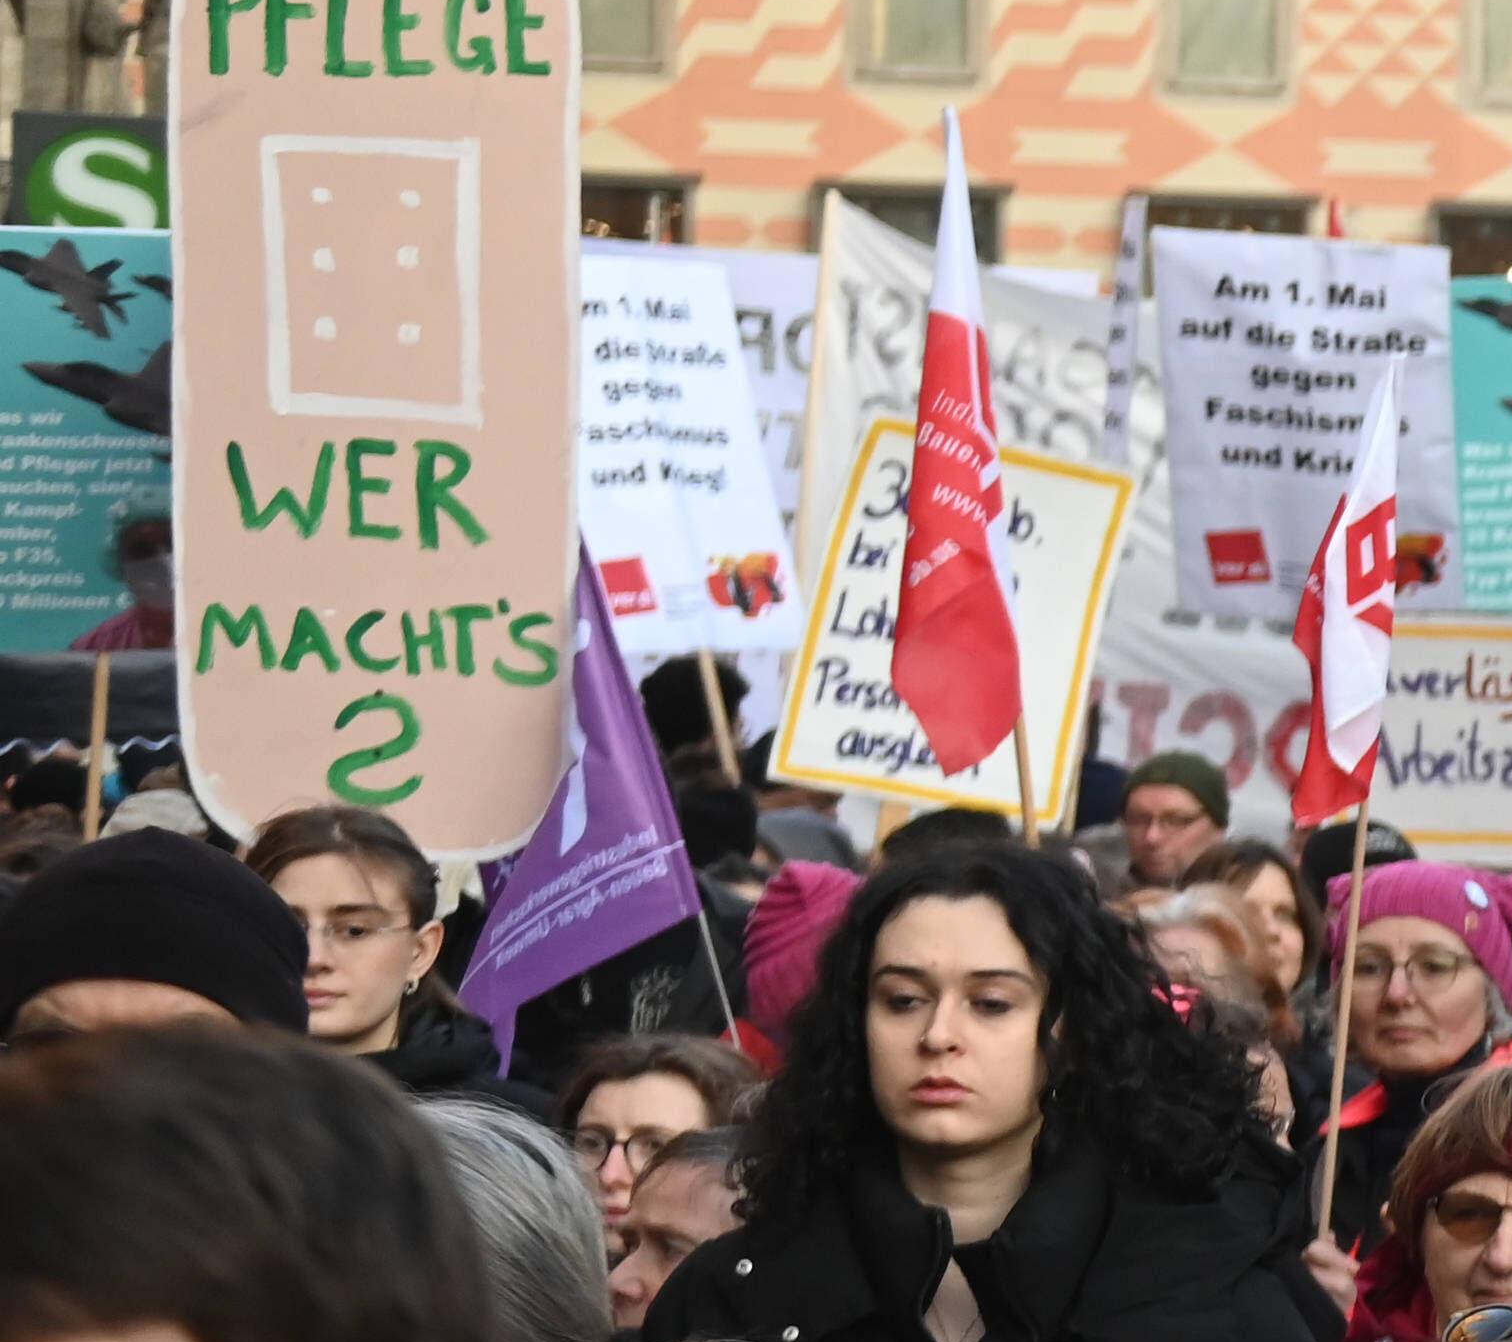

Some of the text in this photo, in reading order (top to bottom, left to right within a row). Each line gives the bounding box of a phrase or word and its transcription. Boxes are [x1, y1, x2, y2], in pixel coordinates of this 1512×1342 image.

[1213, 274, 1270, 304] Am
[1327, 285, 1388, 310] Mai
[1180, 318, 1427, 357] auf die Straße
[1250, 363, 1357, 394] gegen
[584, 417, 730, 447] aschismus
[1205, 397, 1410, 438] Faschisms
[591, 460, 646, 488] und
[1220, 443, 1283, 469] und
[226, 438, 489, 549] WER
[196, 599, 558, 687] MACHT'S
